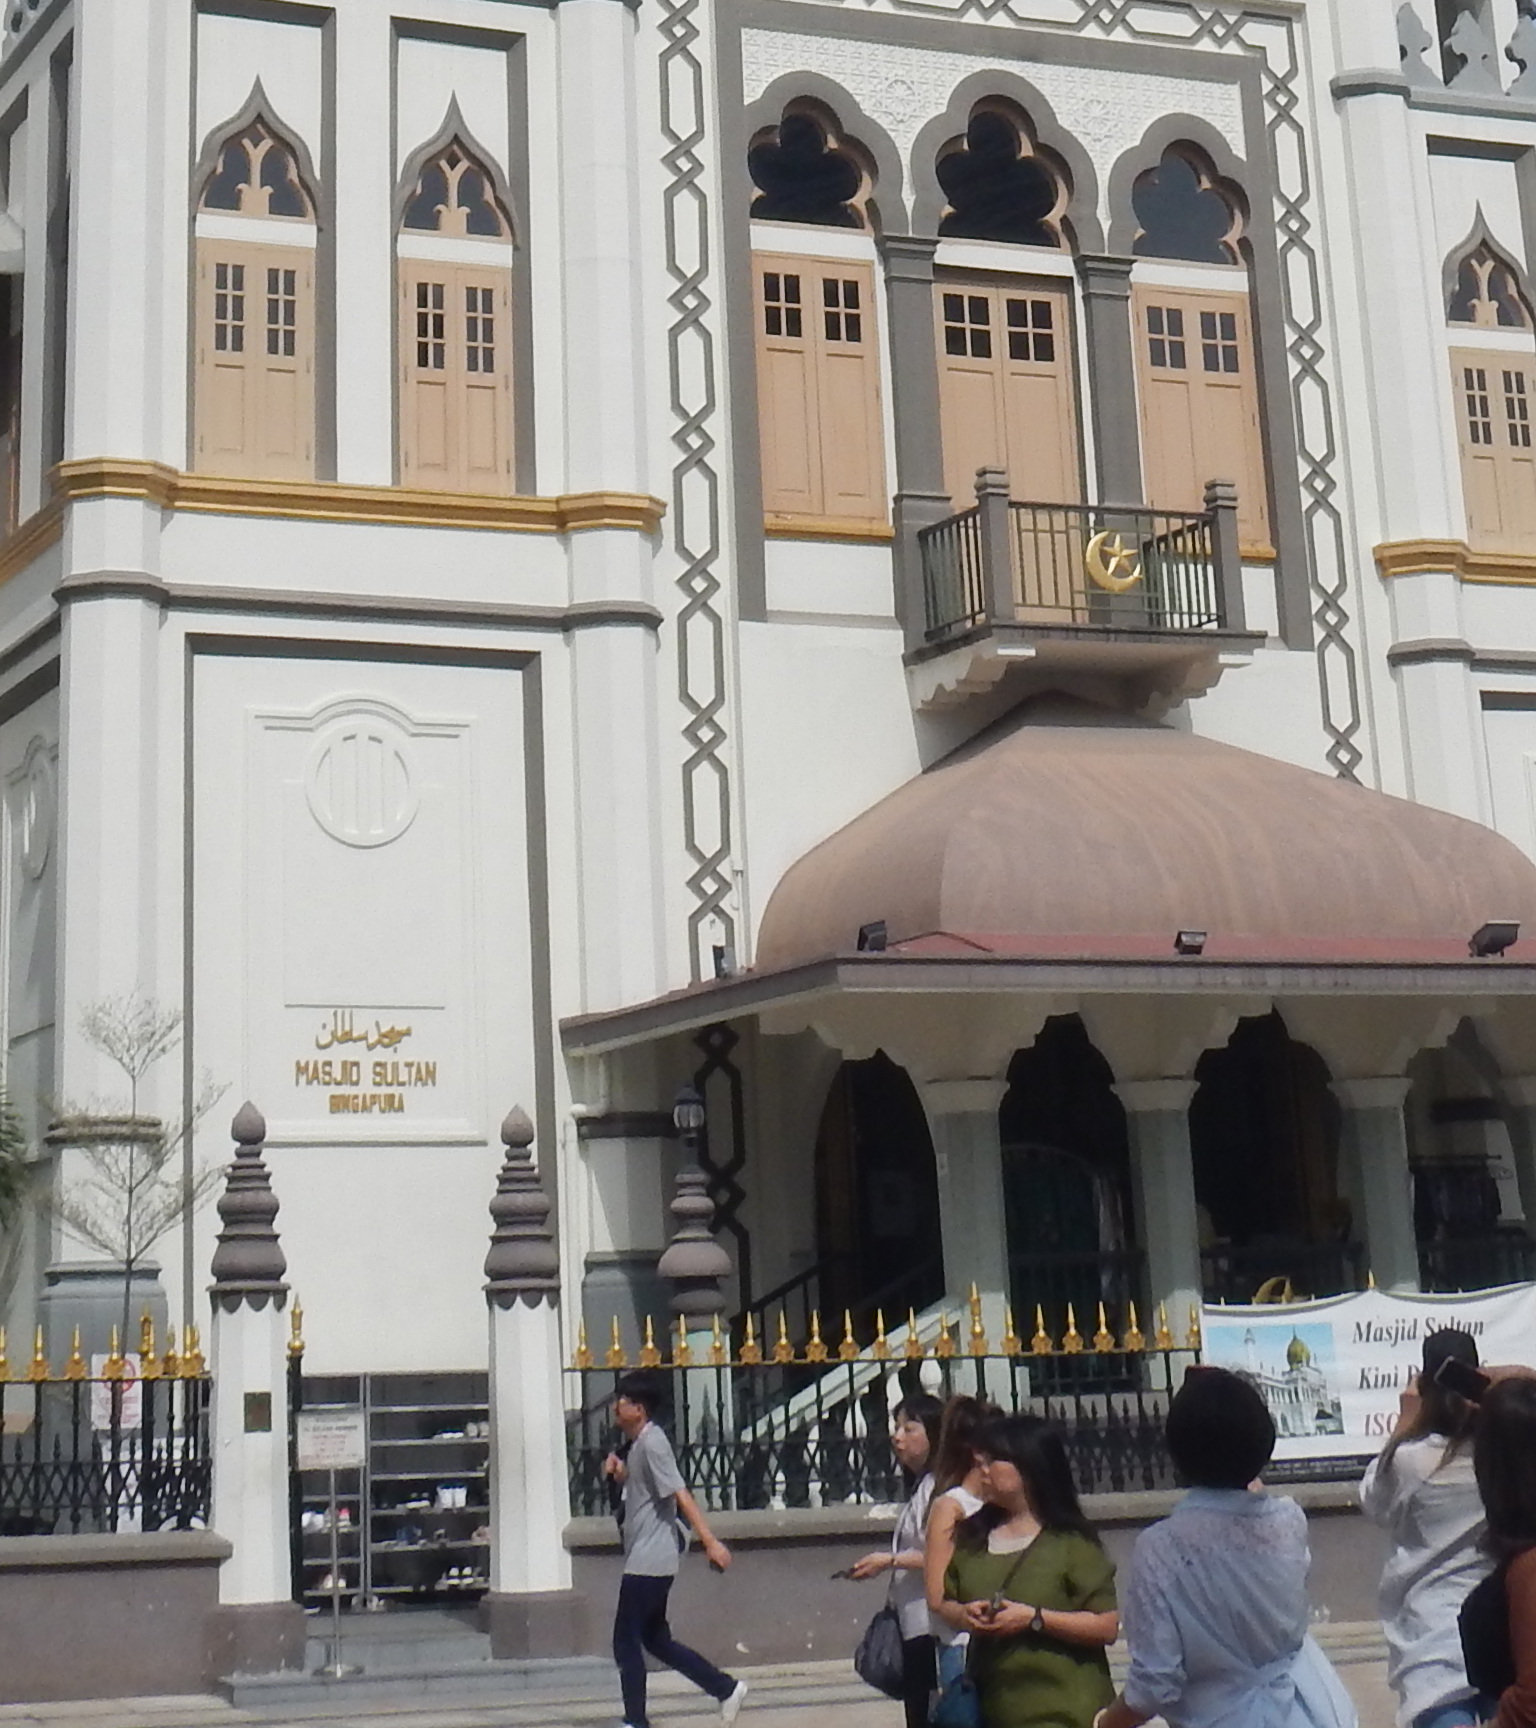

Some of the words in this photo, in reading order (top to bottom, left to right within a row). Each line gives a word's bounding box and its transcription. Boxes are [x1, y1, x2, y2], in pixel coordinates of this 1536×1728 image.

[295, 1059, 361, 1087] MASJID
[371, 1060, 437, 1087] SULTAN
[1353, 1318, 1418, 1347] Masjid
[1359, 1365, 1399, 1390] Kini
